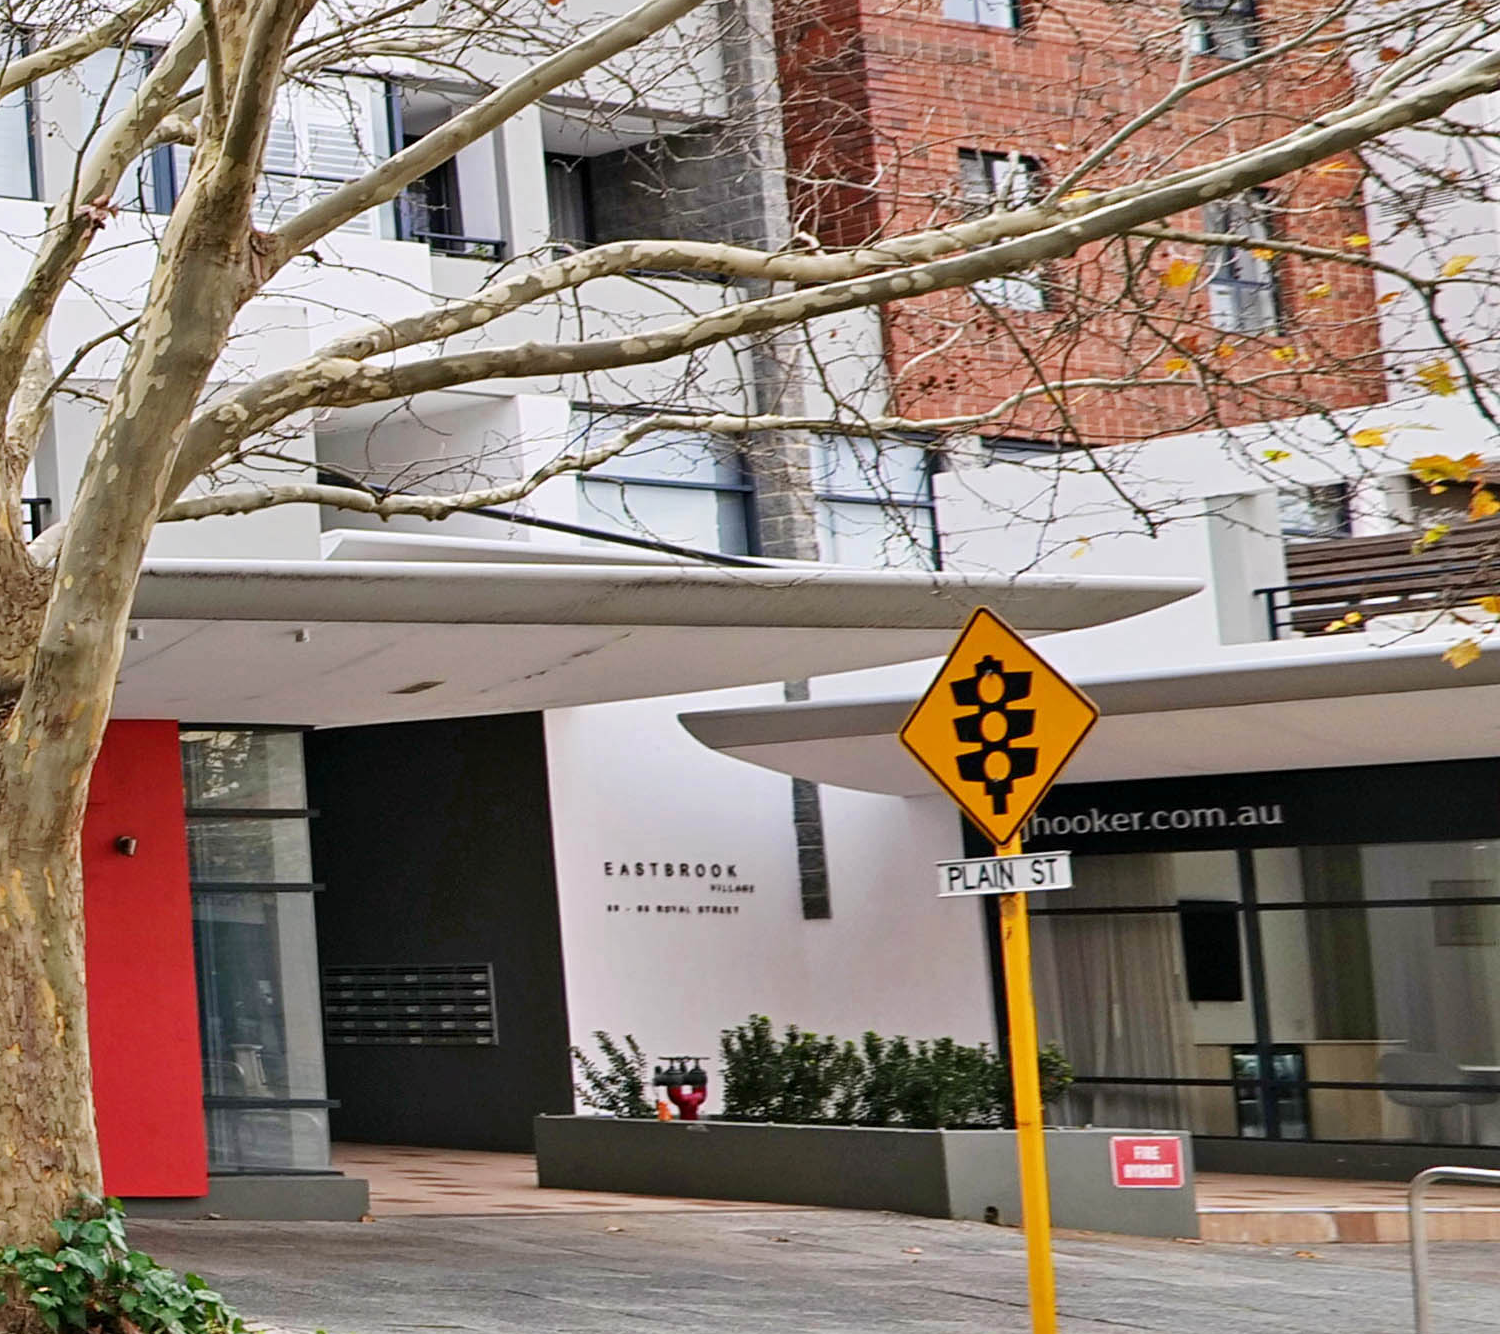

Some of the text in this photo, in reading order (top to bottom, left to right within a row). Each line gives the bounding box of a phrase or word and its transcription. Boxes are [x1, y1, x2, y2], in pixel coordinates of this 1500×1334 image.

[1021, 804, 1284, 843] jhooker.com.au
[604, 862, 737, 878] EASTBROOK
[948, 857, 1058, 893] PLAIN ST
[698, 905, 739, 915] STREET
